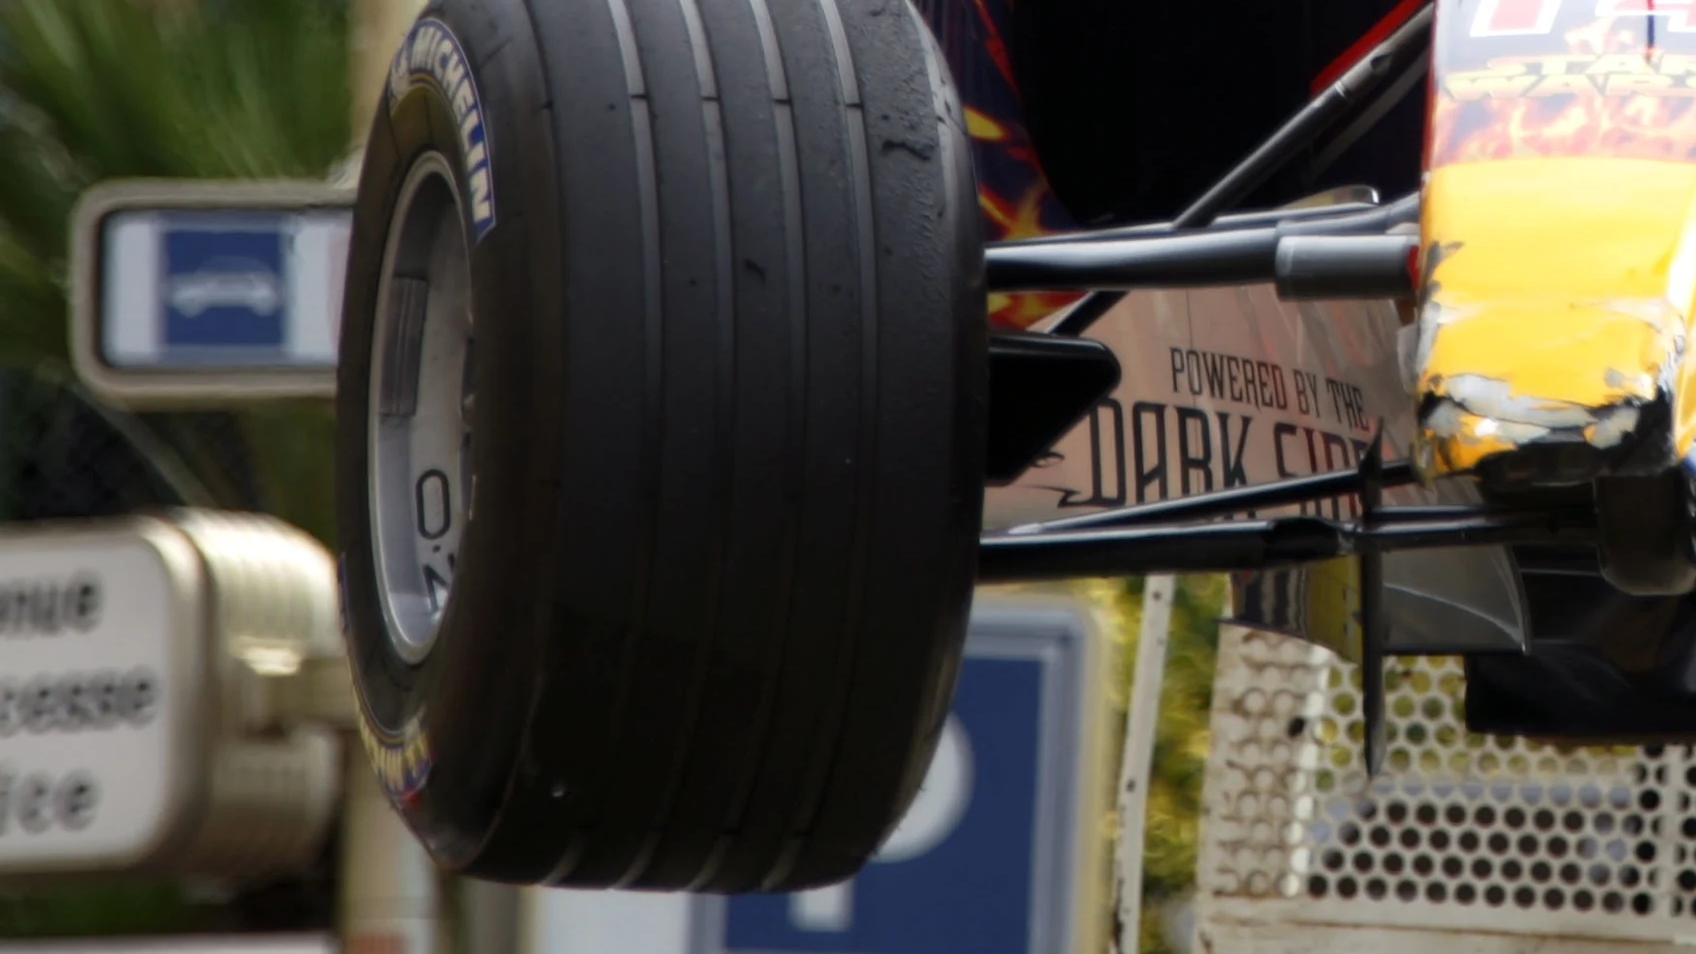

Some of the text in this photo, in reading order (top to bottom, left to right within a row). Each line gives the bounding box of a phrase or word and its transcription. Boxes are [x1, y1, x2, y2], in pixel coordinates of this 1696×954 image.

[409, 25, 491, 223] MICHELIN
[1170, 347, 1371, 432] POWERED BY THE
[1057, 396, 1253, 522] DARK
